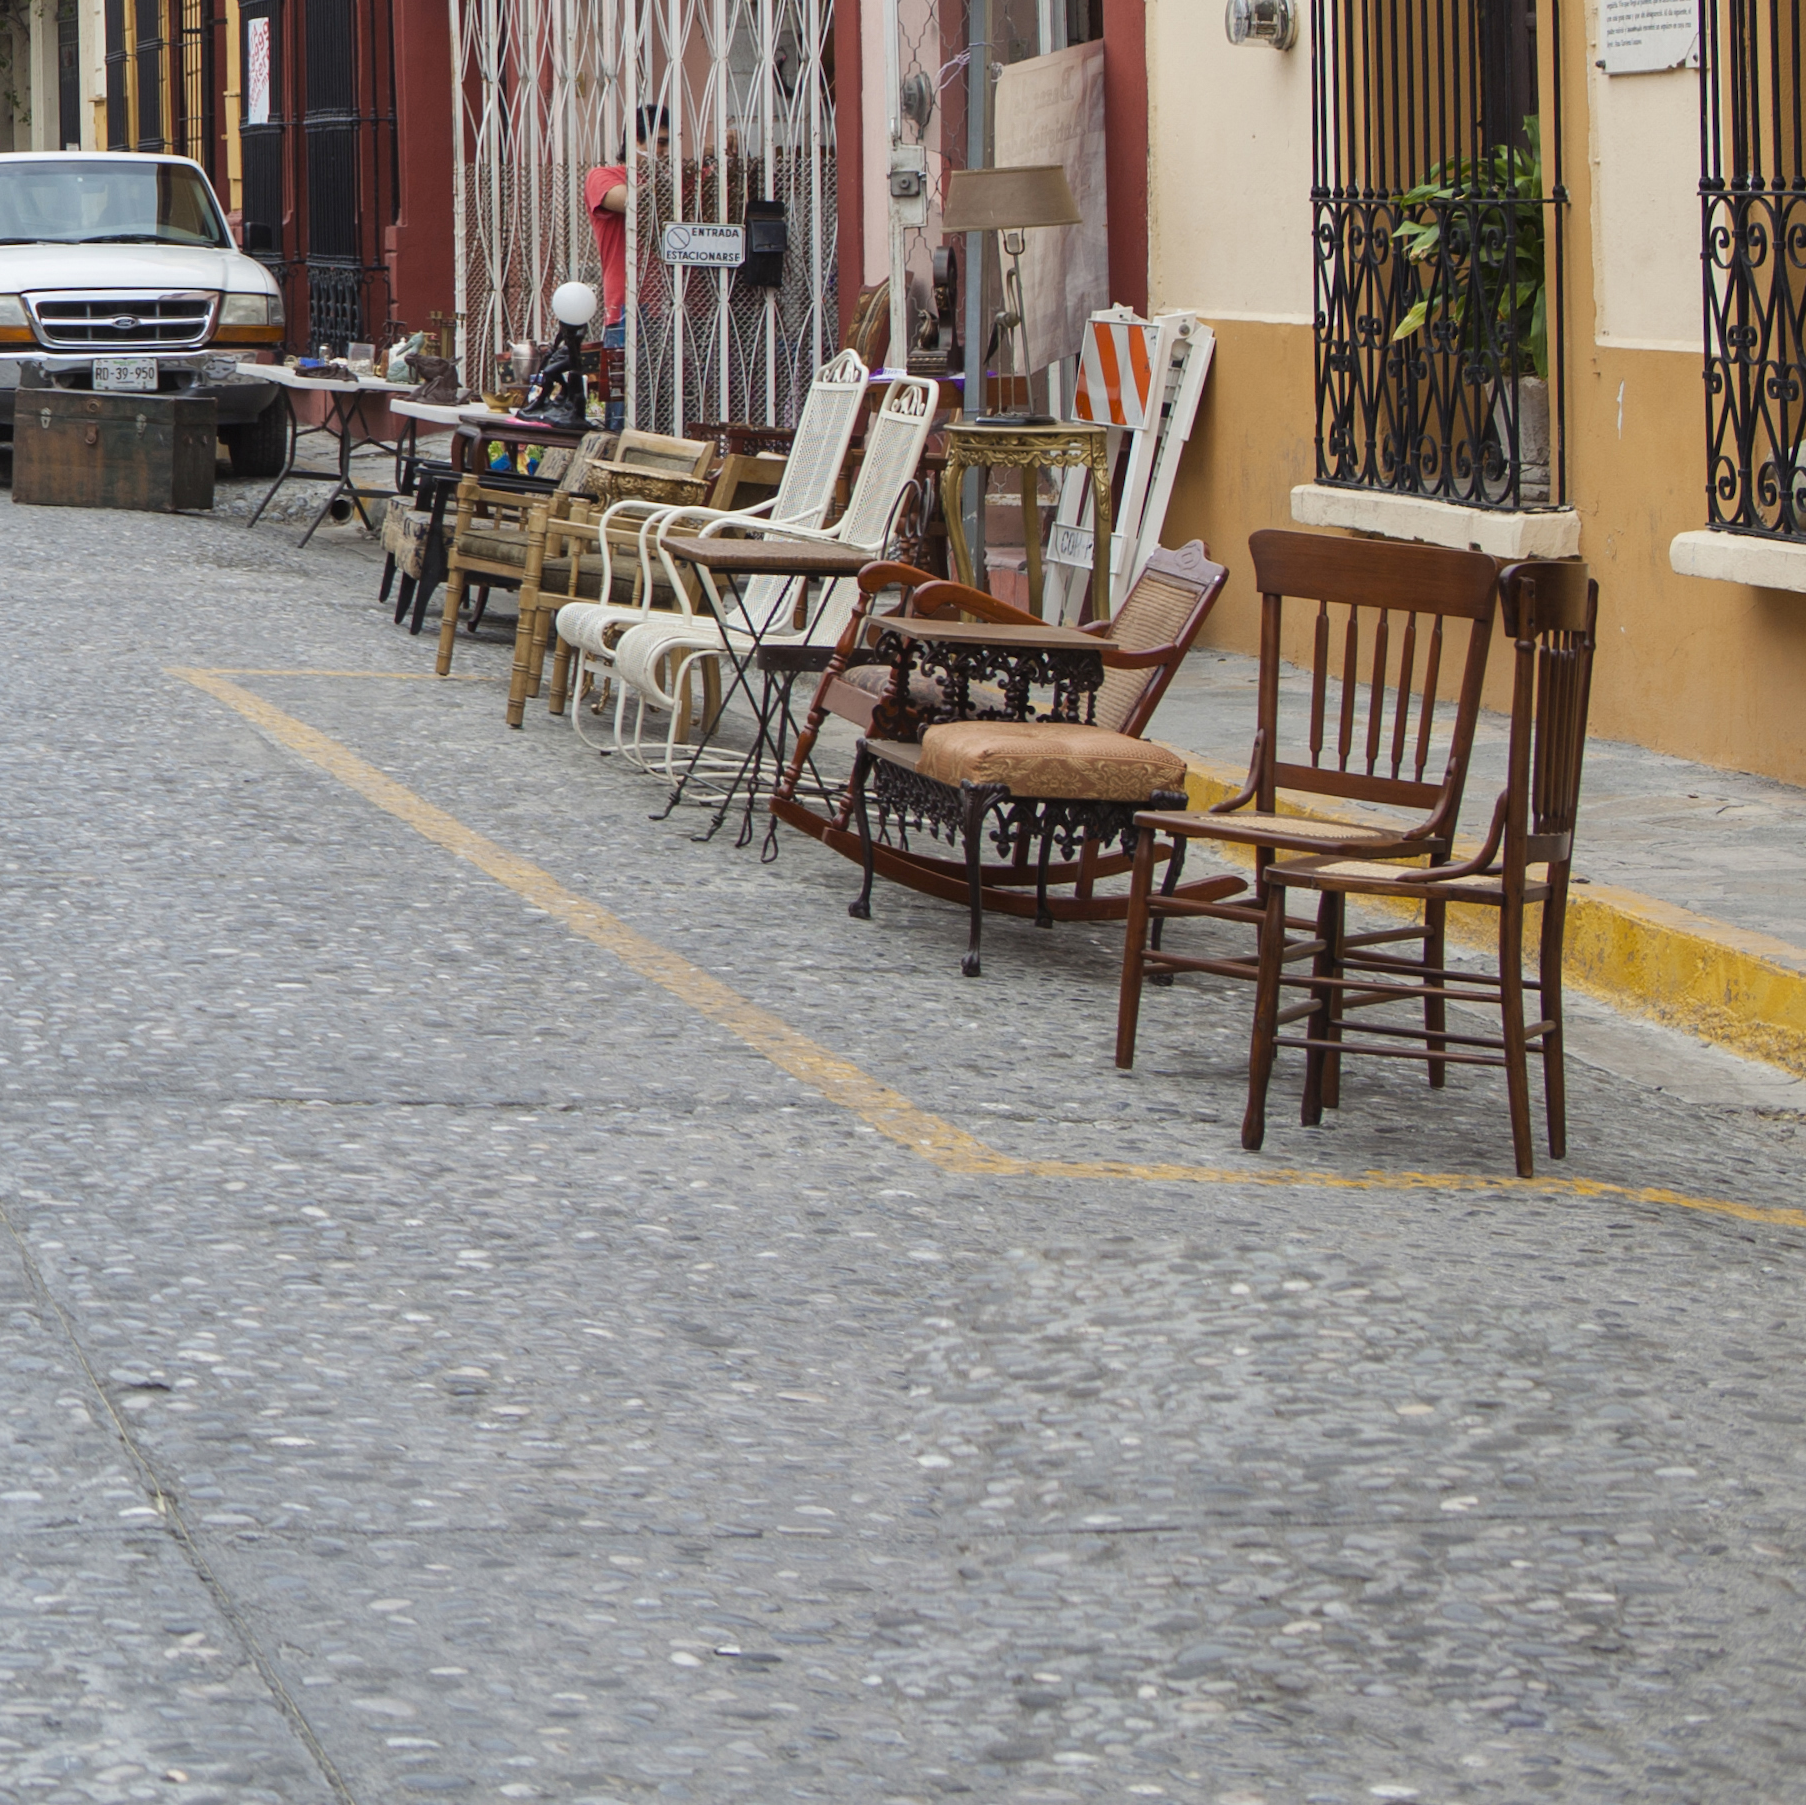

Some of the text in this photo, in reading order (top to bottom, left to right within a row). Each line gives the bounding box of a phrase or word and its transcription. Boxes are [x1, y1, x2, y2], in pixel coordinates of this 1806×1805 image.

[691, 227, 740, 238] ENTRADA
[666, 250, 741, 262] ESTACIONARSE
[95, 367, 155, 381] RD-39-950
